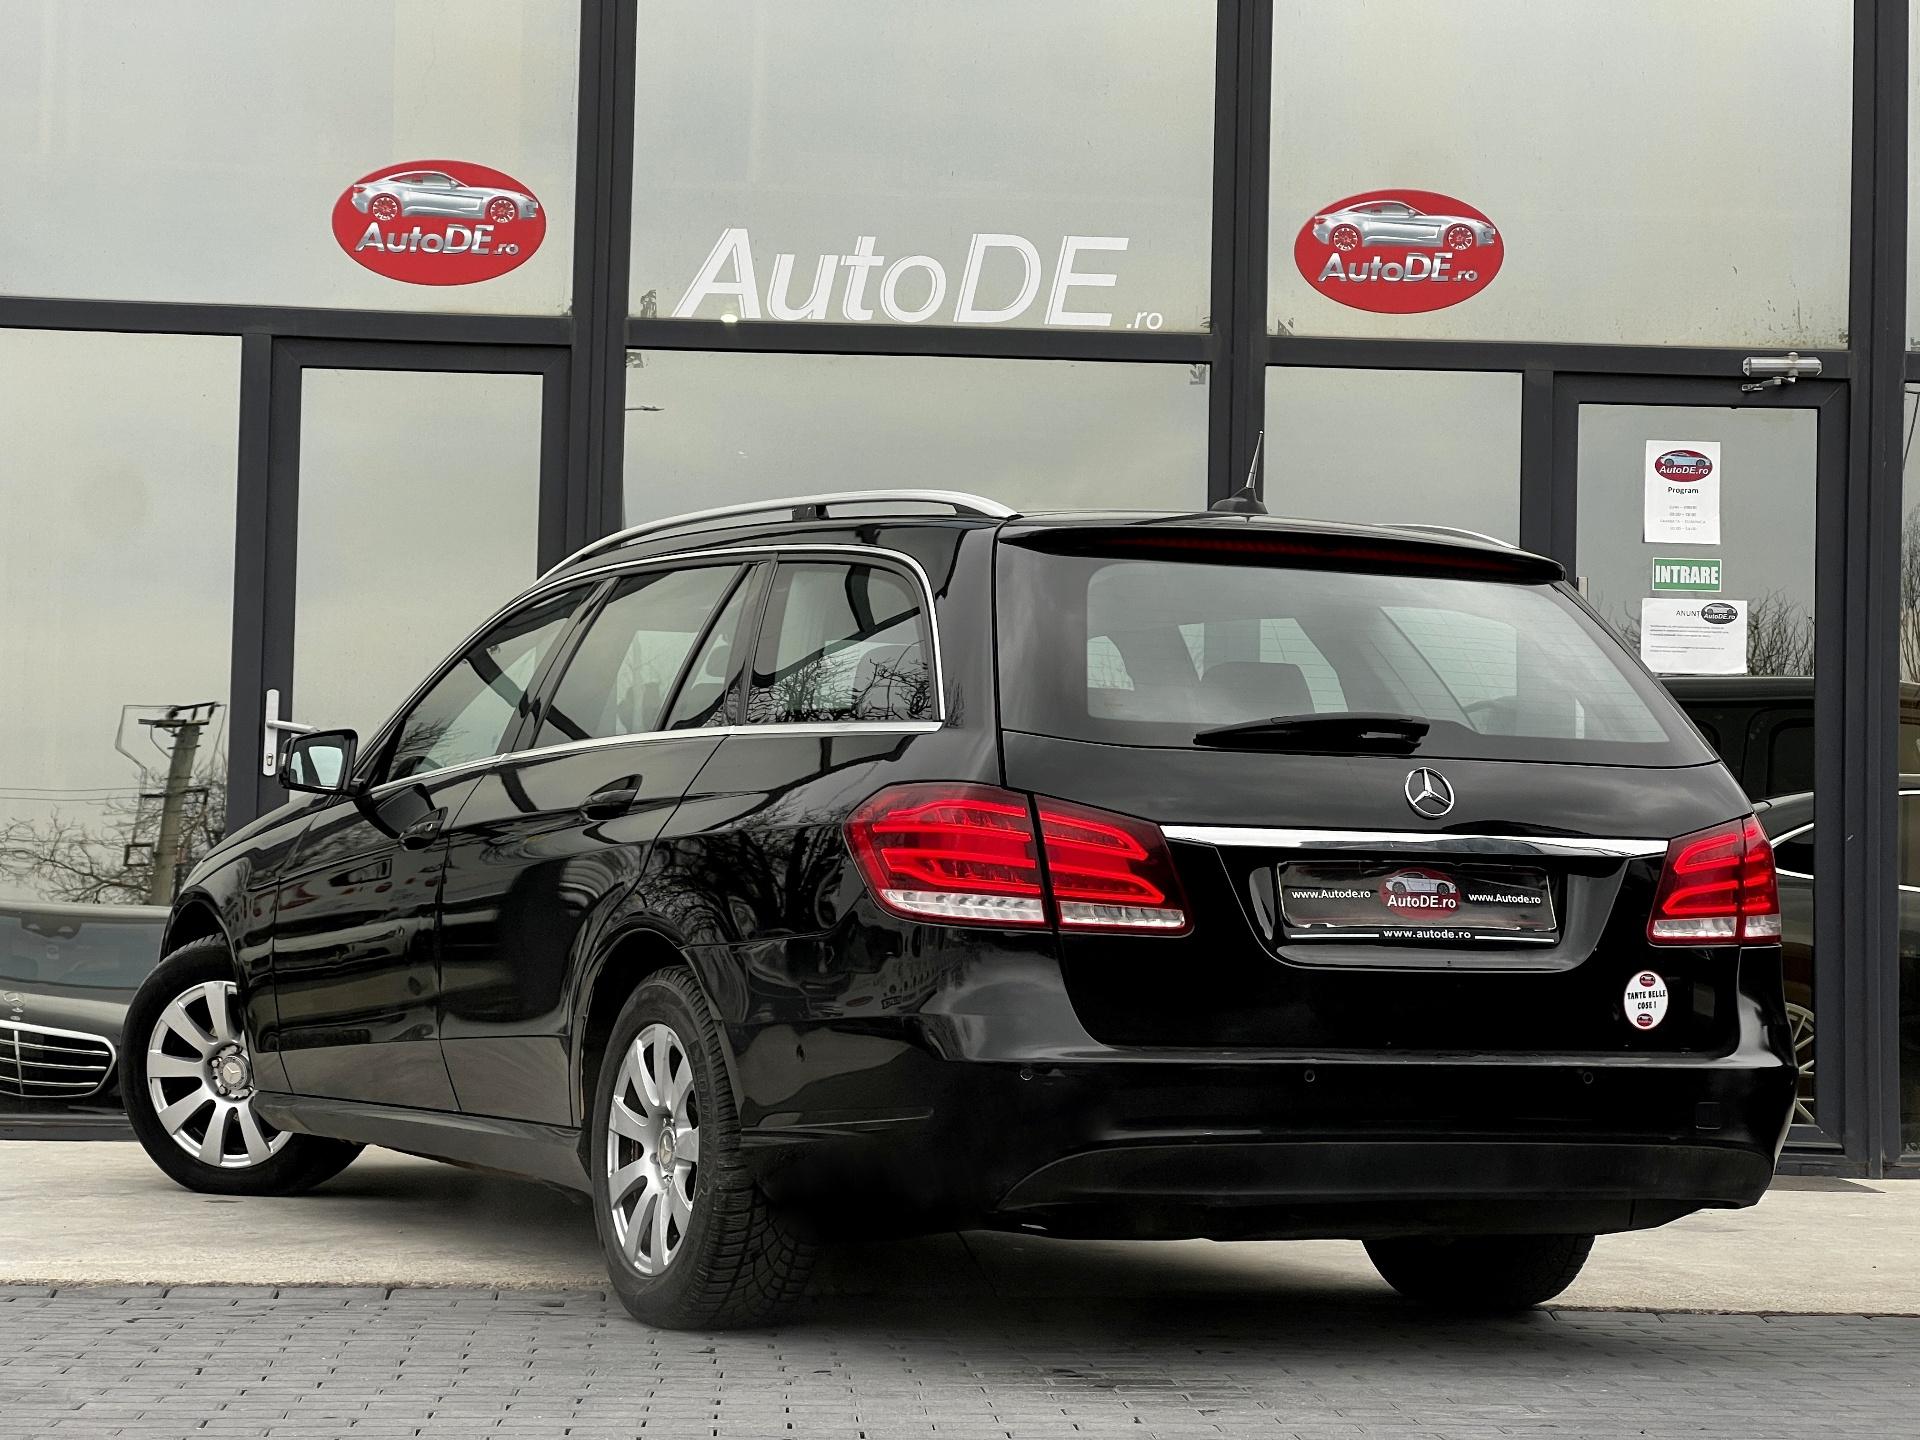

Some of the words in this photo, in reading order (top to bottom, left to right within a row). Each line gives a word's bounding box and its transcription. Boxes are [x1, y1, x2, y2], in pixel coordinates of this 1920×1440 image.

[1659, 465, 1709, 475] AutoDE.ro
[1667, 486, 1699, 494] Program
[1655, 565, 1719, 584] INTRARE
[1291, 889, 1371, 900] www.Autode.ro
[1468, 893, 1541, 905] www.Autode.ro
[1387, 894, 1457, 909] AutoDE.ro
[1383, 928, 1471, 940] www.autode.ro
[1648, 990, 1666, 998] BELLE
